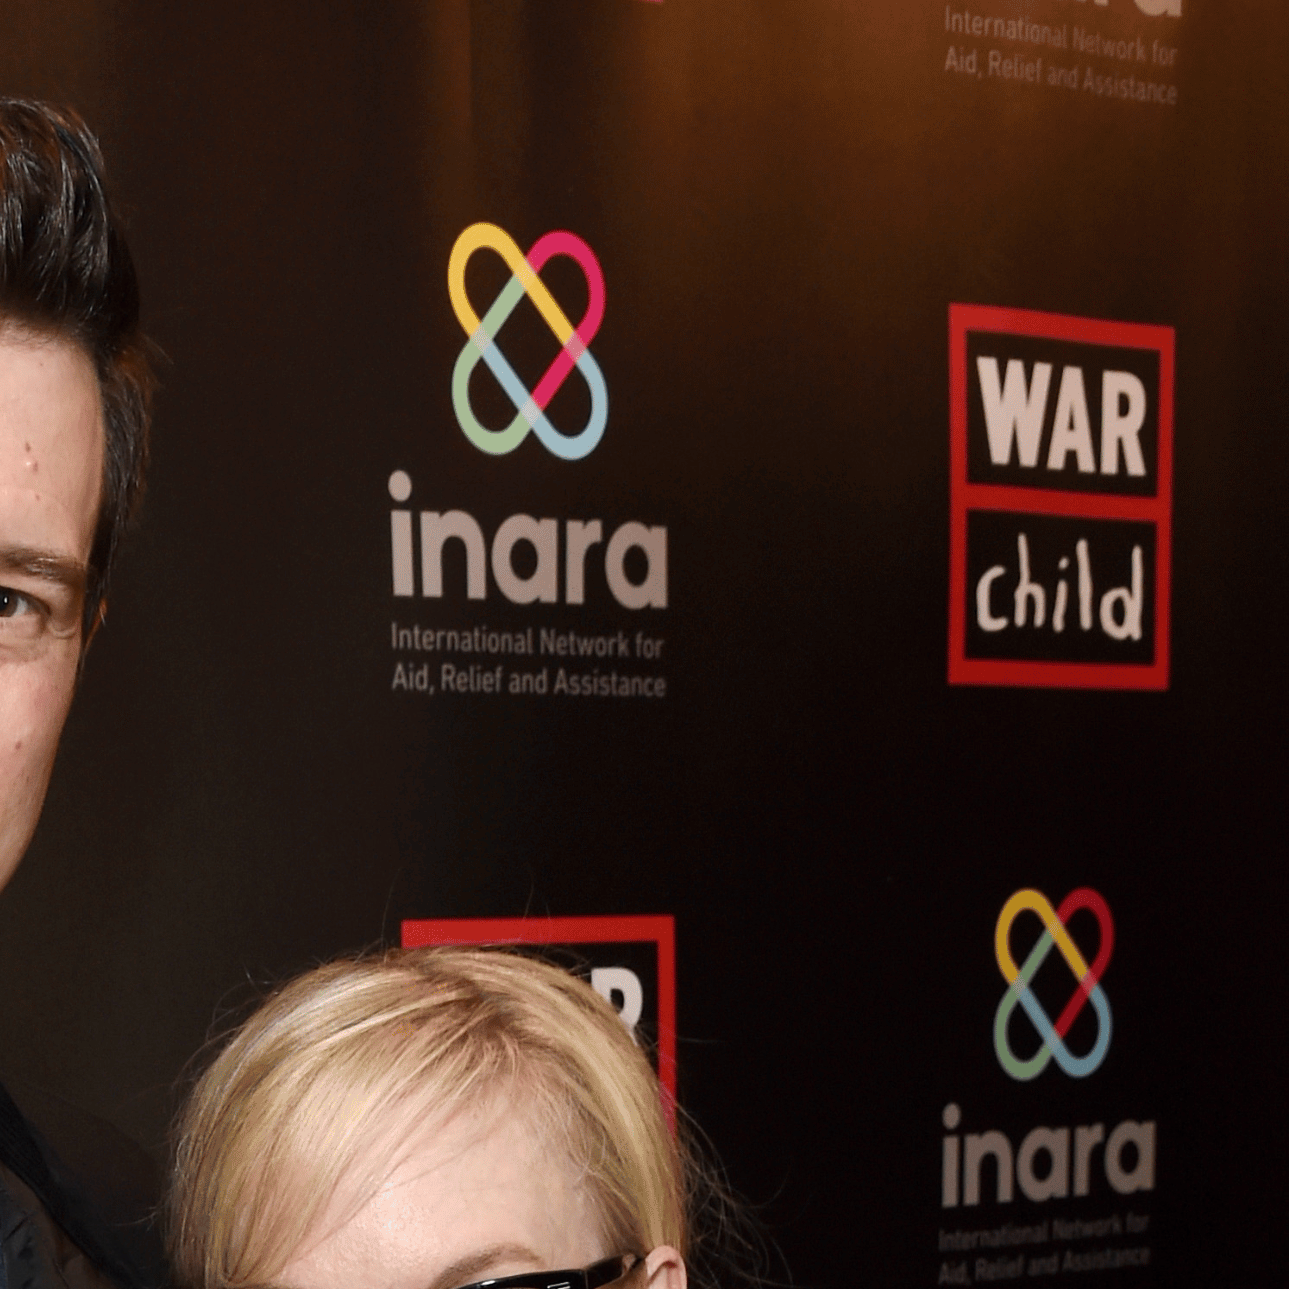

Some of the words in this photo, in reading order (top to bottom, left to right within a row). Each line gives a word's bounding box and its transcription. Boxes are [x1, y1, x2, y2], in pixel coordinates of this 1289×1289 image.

[944, 5, 1067, 48] International
[1073, 26, 1146, 62] Network
[1152, 39, 1178, 66] for
[988, 50, 1042, 83] Relief
[1047, 65, 1079, 90] and
[1083, 66, 1178, 105] Assistance
[976, 355, 1147, 477] WAR
[388, 469, 668, 610] inara
[976, 532, 1143, 642] child
[391, 621, 533, 655] International
[539, 627, 630, 658] Network
[636, 630, 664, 660] for
[391, 662, 435, 696] Aid,
[441, 663, 503, 693] Relief
[509, 667, 547, 696] and
[553, 668, 667, 698] Assistance
[942, 1102, 1156, 1209] inara
